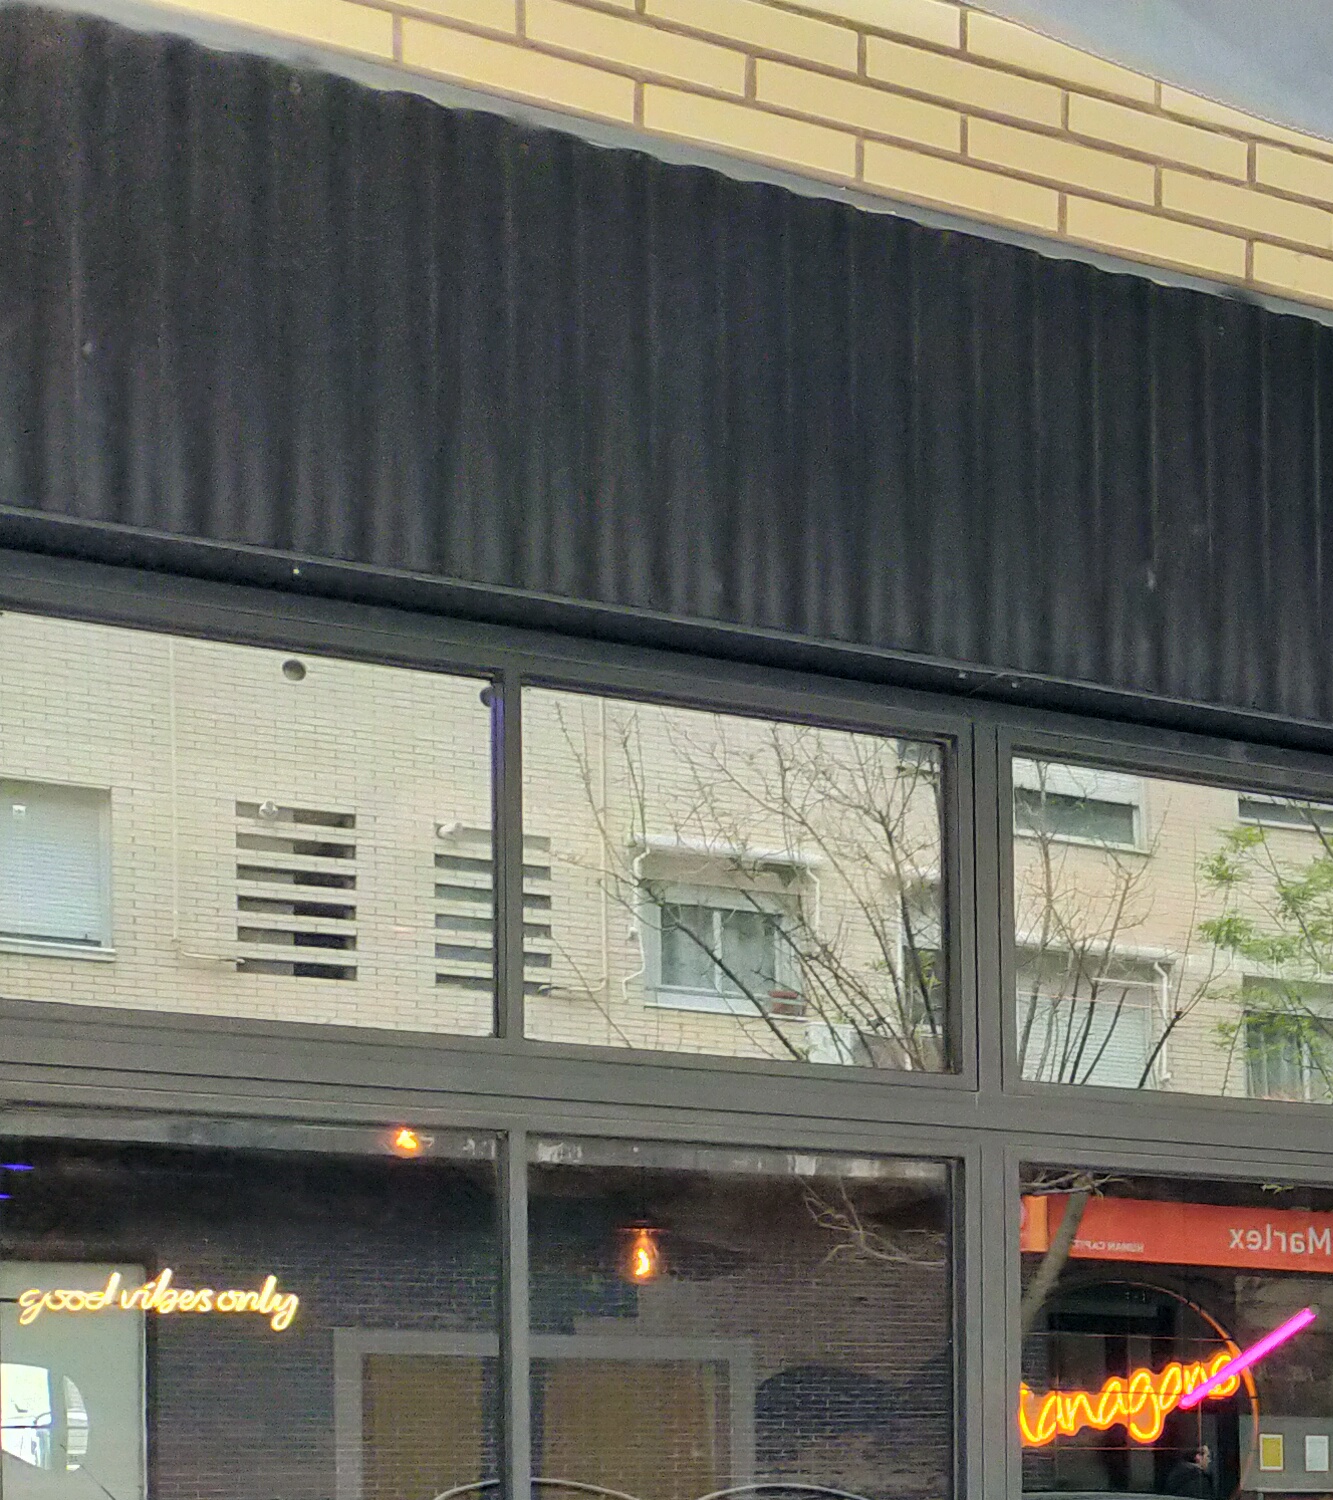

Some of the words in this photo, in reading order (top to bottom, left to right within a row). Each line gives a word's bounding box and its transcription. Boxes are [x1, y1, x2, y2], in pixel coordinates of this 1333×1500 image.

[19, 1272, 121, 1325] good
[121, 1268, 213, 1313] vibes
[217, 1274, 299, 1332] only
